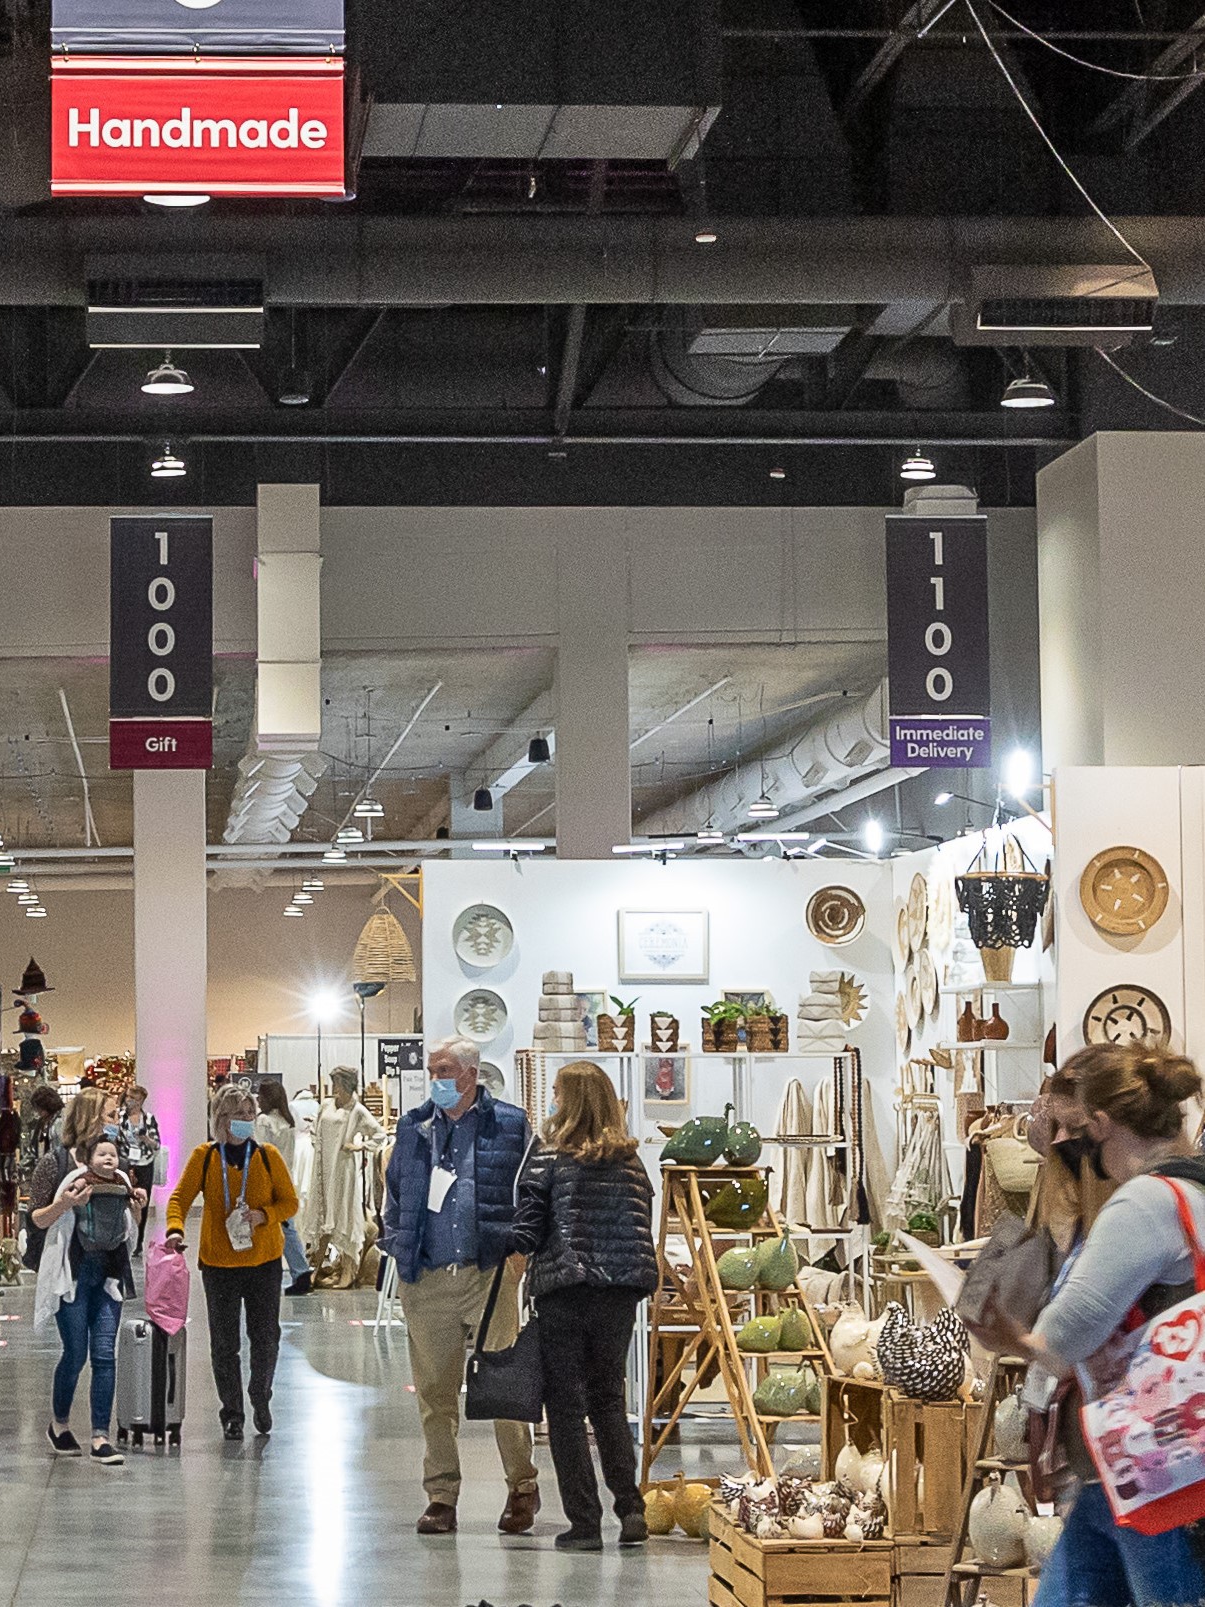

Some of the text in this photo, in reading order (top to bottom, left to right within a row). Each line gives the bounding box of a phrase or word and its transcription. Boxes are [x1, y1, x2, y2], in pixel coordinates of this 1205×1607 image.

[69, 108, 327, 148] Handmade
[148, 532, 175, 701] 1000
[925, 532, 953, 701] 1100
[146, 737, 177, 751] Gift
[896, 726, 984, 740] Immediate
[908, 743, 973, 761] Delivery
